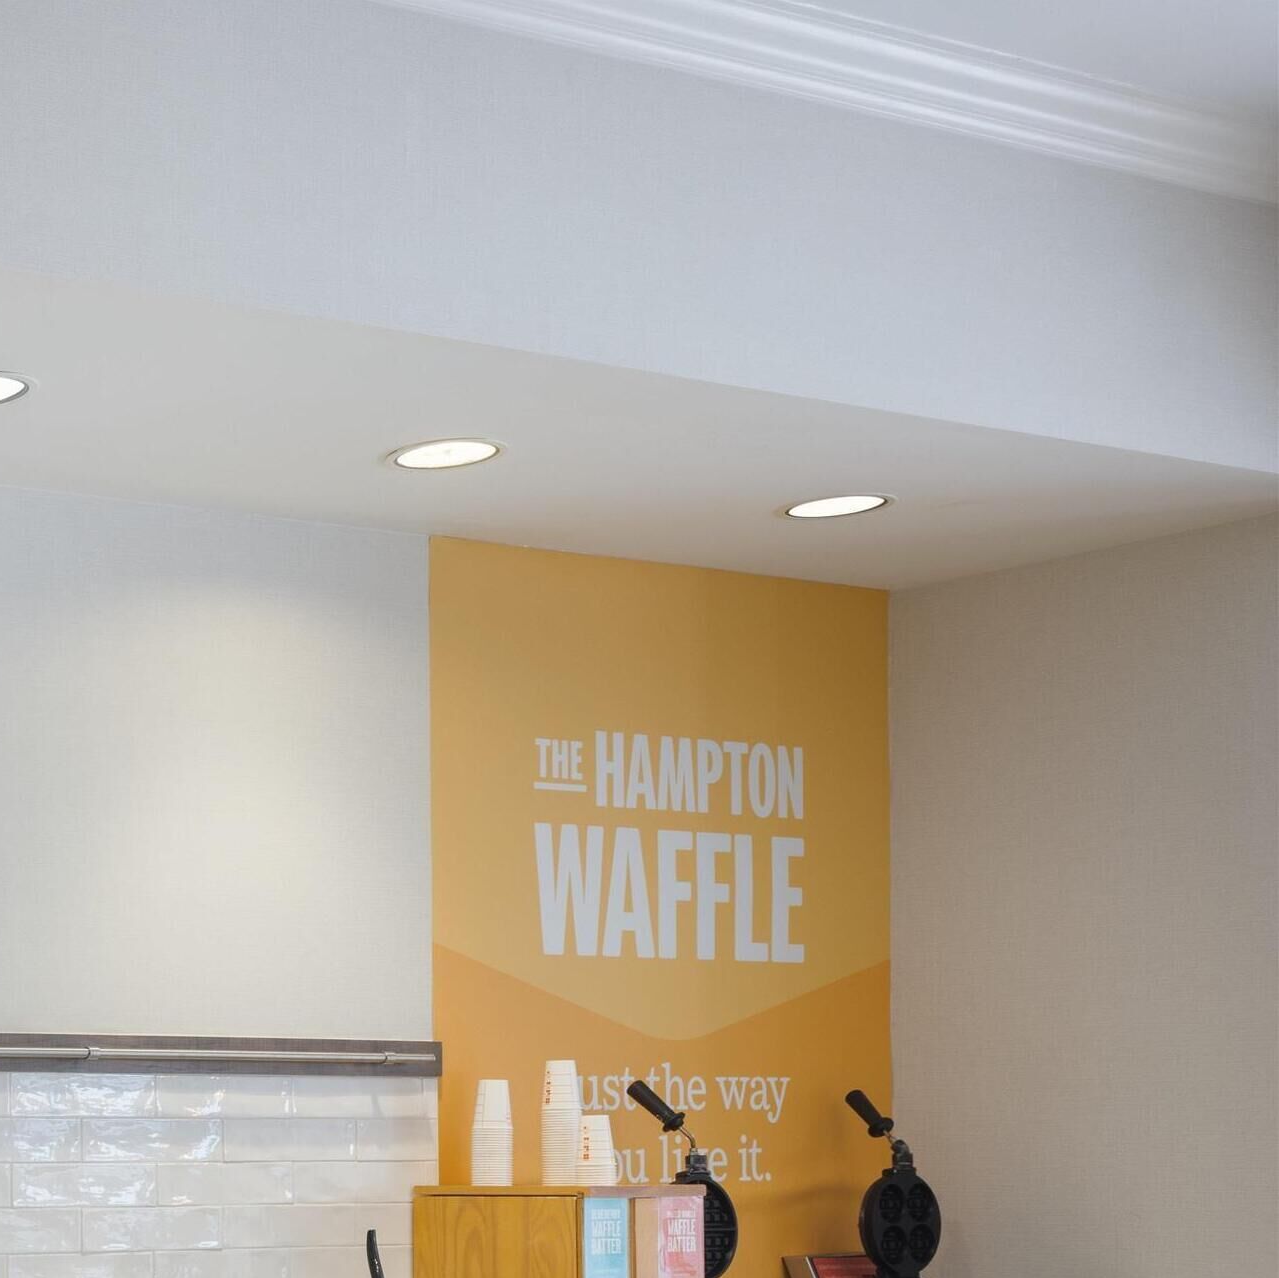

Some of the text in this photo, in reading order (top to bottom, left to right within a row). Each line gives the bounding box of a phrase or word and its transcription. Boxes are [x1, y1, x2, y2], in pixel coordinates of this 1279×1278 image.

[534, 730, 804, 820] THE HAMPTON
[533, 821, 805, 963] WAFFLE
[576, 1066, 636, 1111] ust
[715, 1075, 790, 1124] way
[658, 1134, 728, 1184] lie
[738, 1134, 772, 1182] it.
